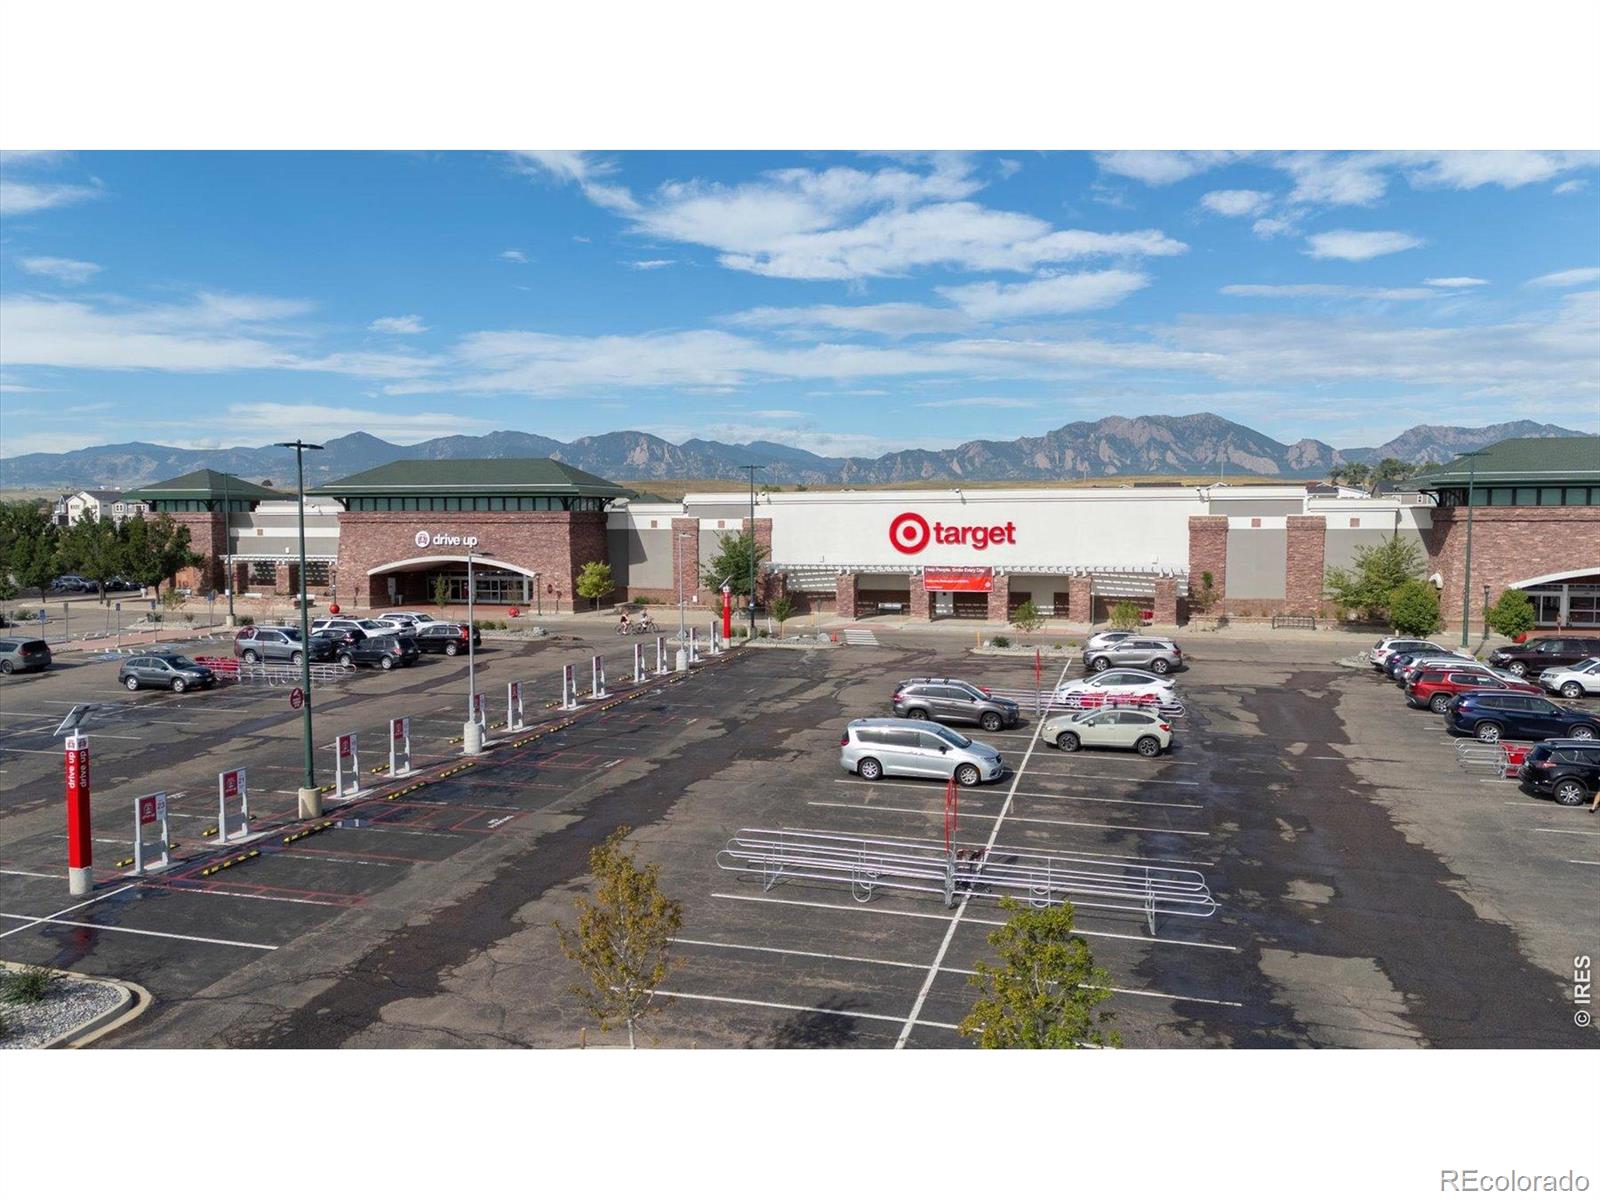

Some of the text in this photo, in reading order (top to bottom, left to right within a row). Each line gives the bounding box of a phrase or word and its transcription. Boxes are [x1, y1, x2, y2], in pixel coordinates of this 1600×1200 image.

[433, 533, 478, 548] drive up
[933, 521, 1016, 550] target
[68, 751, 76, 789] drive up
[79, 750, 87, 788] drive up
